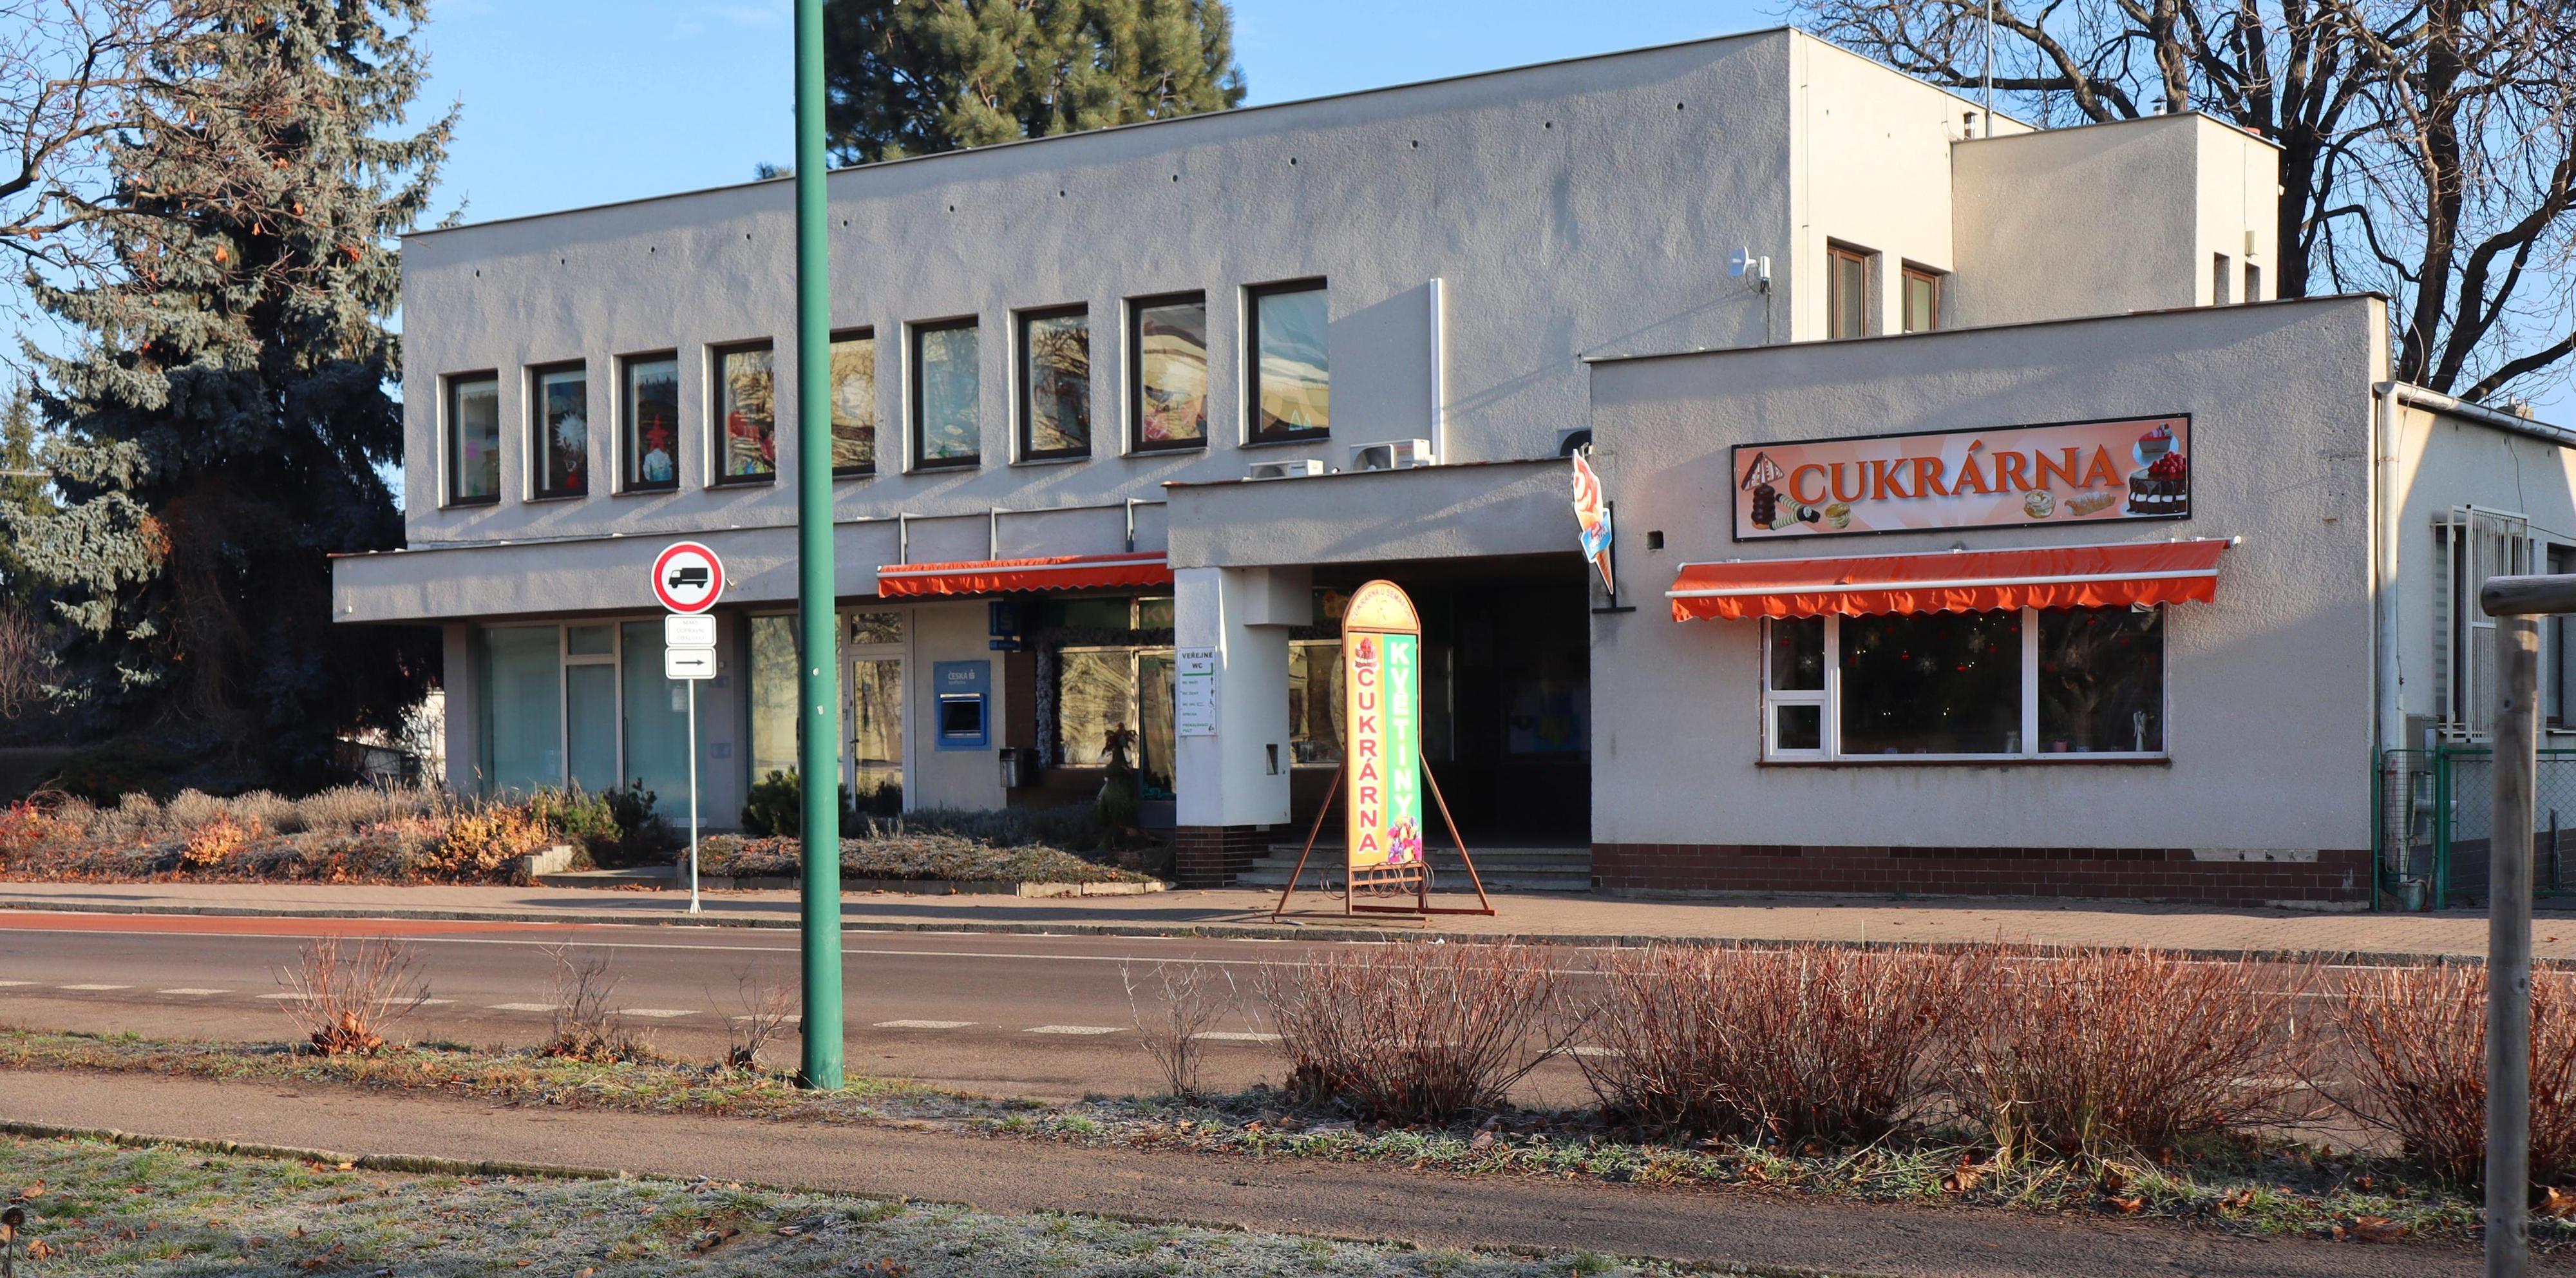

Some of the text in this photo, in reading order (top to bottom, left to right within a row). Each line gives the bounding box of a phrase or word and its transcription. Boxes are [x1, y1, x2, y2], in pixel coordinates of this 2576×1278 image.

[1788, 439, 2125, 505] CUKRÁRNA
[1358, 668, 1378, 852] CUKRÁRNA
[1390, 642, 1413, 817] KVĚTINY
